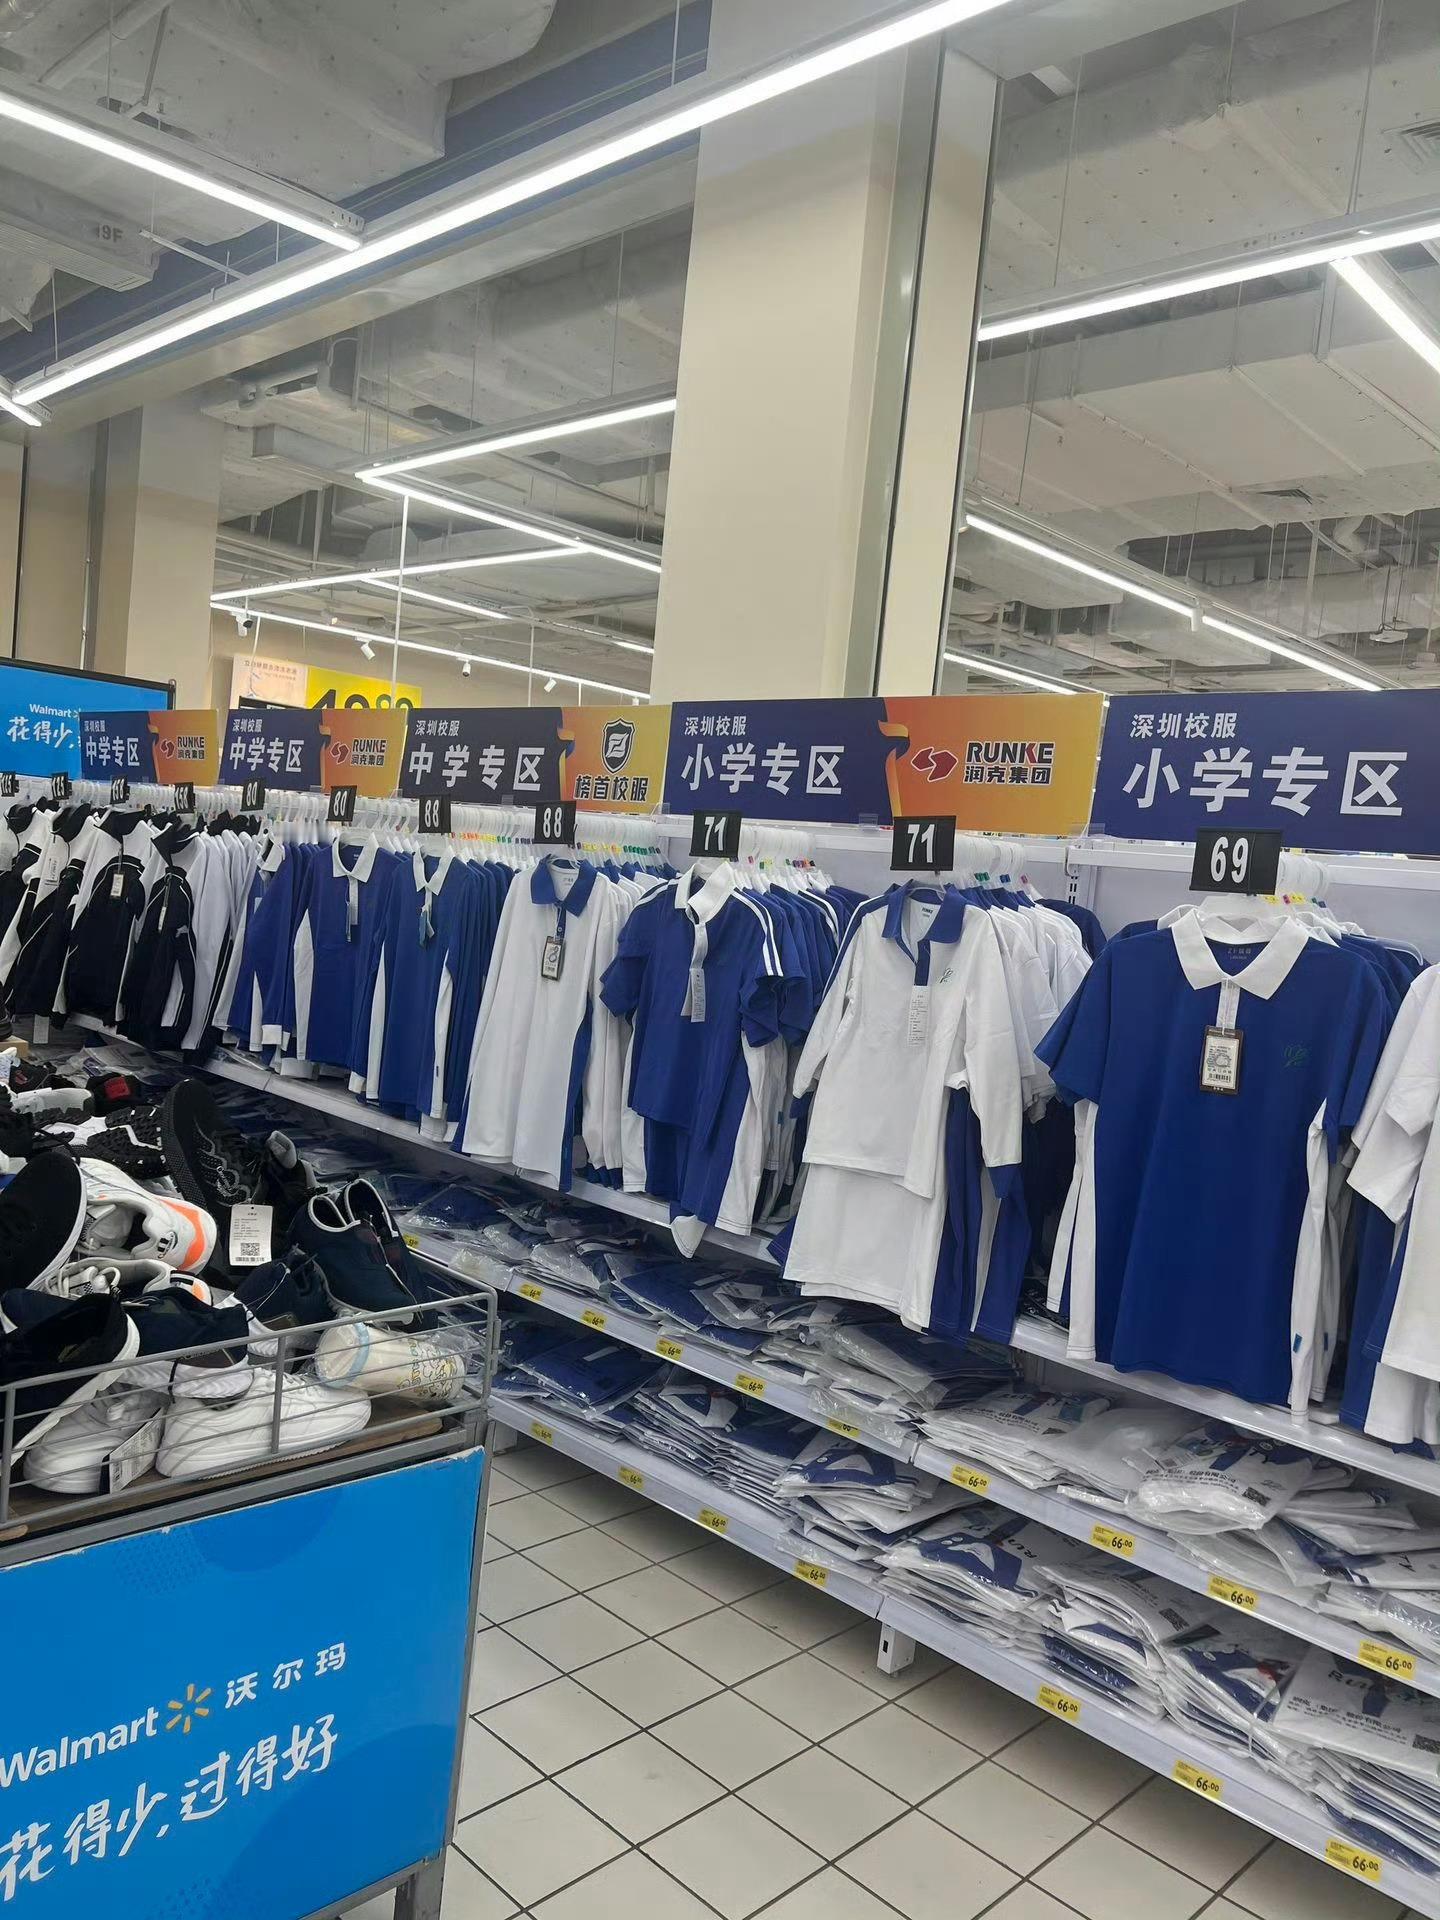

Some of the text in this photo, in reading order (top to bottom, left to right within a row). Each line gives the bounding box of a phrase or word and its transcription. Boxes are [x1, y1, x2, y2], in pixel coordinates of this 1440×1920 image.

[29, 703, 71, 718] Walmart
[7, 716, 80, 748] 花得少,
[232, 719, 262, 732] 深圳校服
[415, 719, 460, 737] 深圳校服
[684, 715, 747, 737] 深圳校服
[1130, 712, 1238, 739] 深圳校服
[85, 736, 140, 767] 中学专区
[177, 736, 205, 748] RUNKE
[352, 739, 387, 753] RUNKE
[966, 741, 1055, 764] RUNKE
[229, 736, 305, 774] 中学专区
[408, 742, 545, 792] 中学专区
[681, 741, 845, 796] 小学专区
[963, 765, 1053, 785] 润克集团
[574, 774, 649, 802] 榜首校服
[1122, 747, 1408, 817] 小学专区
[246, 781, 258, 807] 80
[333, 790, 348, 818] 80
[424, 799, 440, 828] 88
[543, 807, 562, 838] 88
[704, 816, 726, 851] 71
[907, 823, 935, 864] 71
[1210, 836, 1249, 883] 69
[667, 1347, 682, 1356] 66.00
[749, 1382, 764, 1392] 66.00
[968, 1476, 988, 1488] 66.00
[711, 1516, 727, 1528] 66.00
[1111, 1536, 1134, 1549] 66.00
[810, 1569, 827, 1581] 66.00
[1231, 1590, 1255, 1605] 66.00
[1385, 1656, 1413, 1671] 66.00
[225, 1642, 346, 1709] 沃尔玛
[1057, 1699, 1079, 1713] 66.00
[0, 1706, 159, 1788] Walmart
[1196, 1776, 1220, 1792] 66.00
[1352, 1855, 1380, 1872] 66.00
